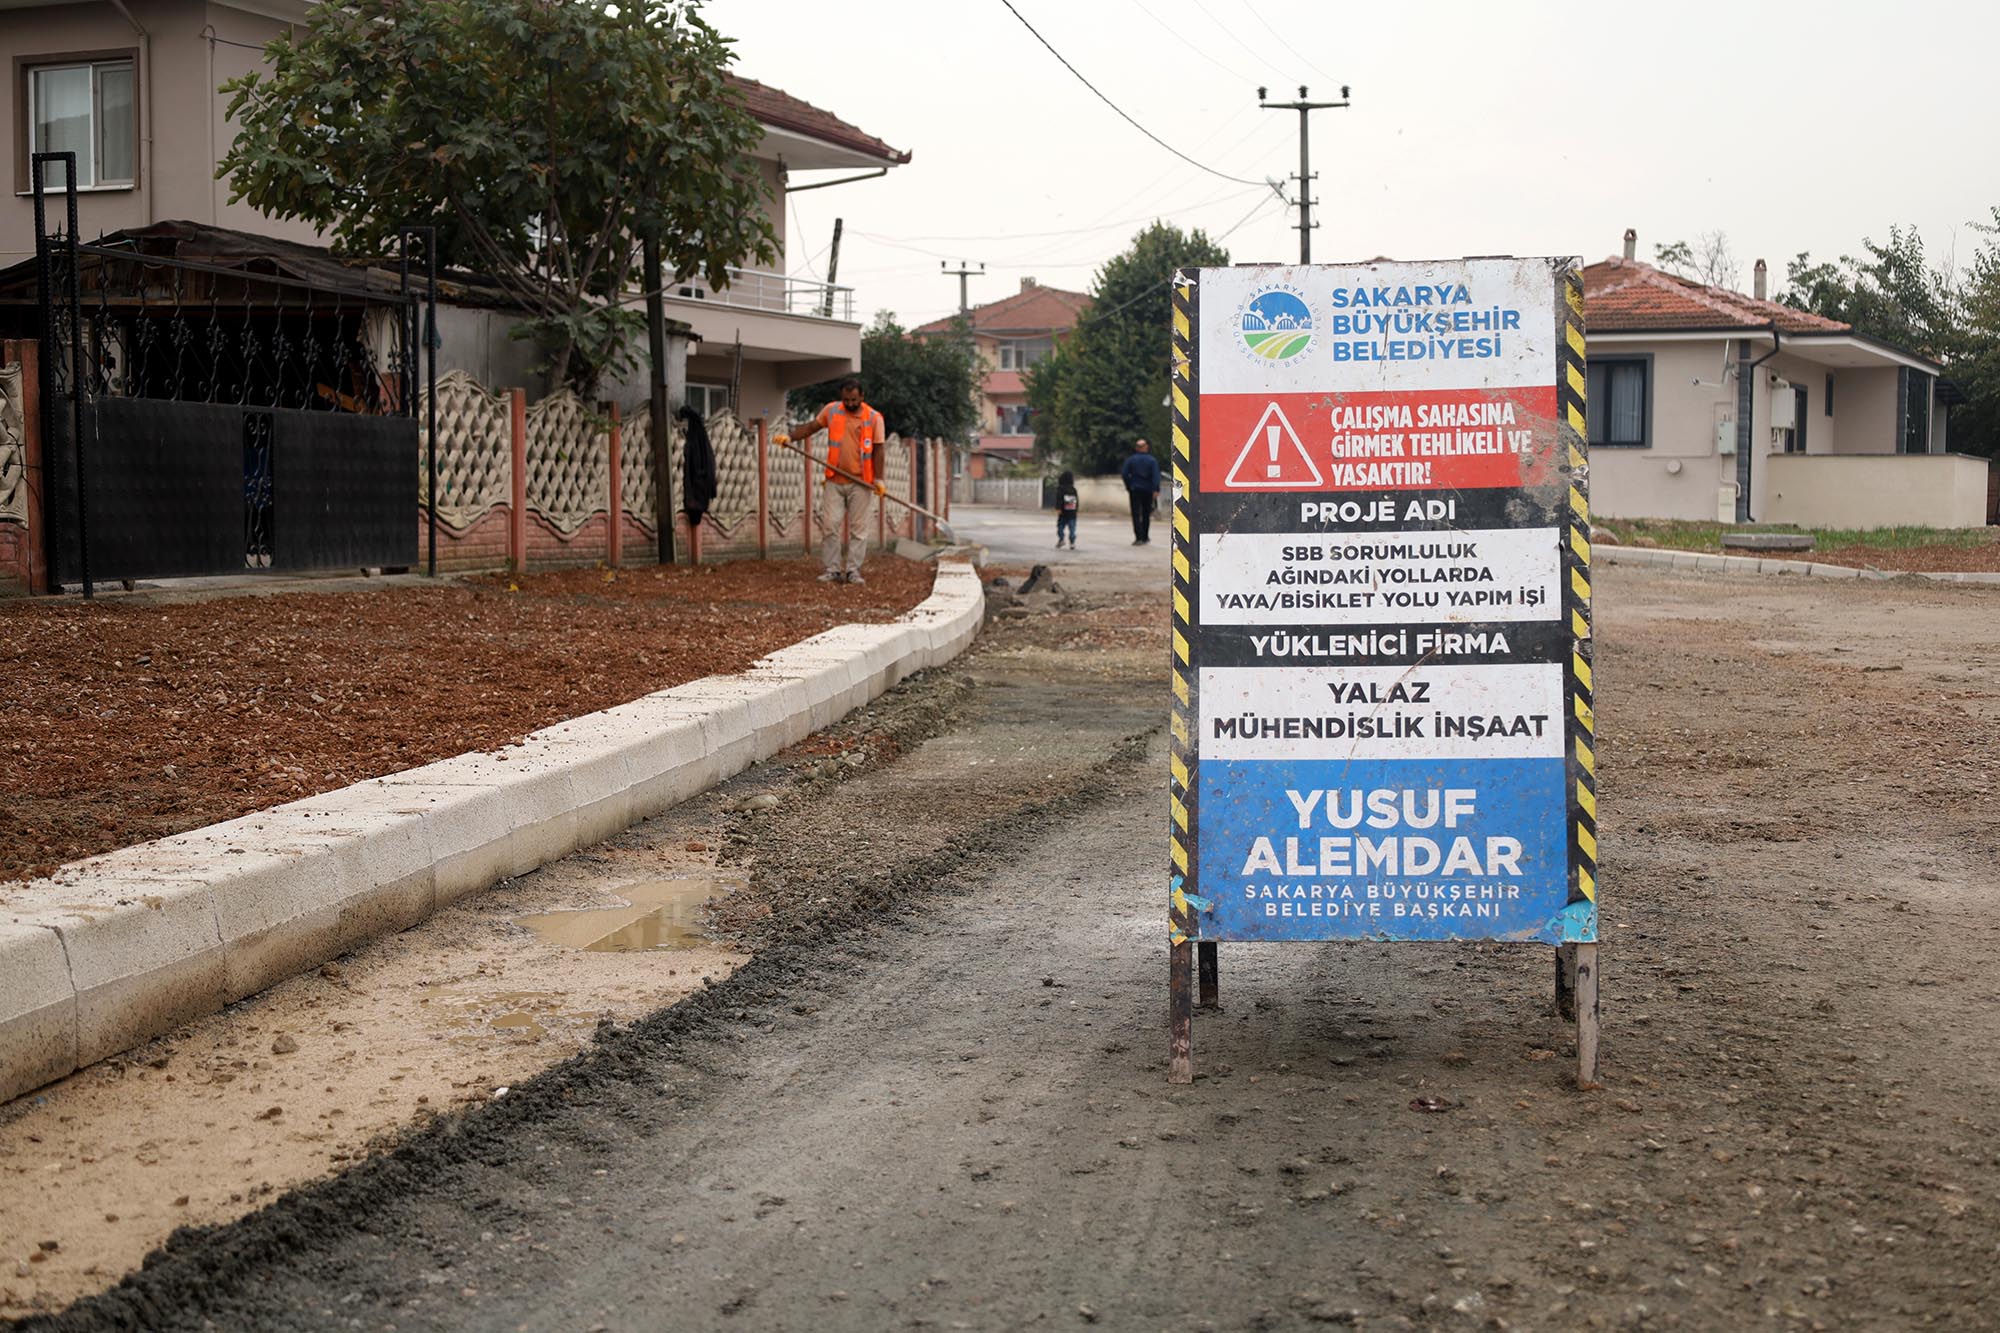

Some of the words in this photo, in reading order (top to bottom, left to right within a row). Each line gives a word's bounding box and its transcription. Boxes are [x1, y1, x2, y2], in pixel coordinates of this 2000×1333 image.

[1332, 285, 1472, 308] SAKARYA
[1332, 306, 1521, 335] BÜYÜKŞEHİR
[1333, 333, 1502, 362] BELEDİYESİ
[1331, 405, 1413, 433] ÇALIŞMA
[1417, 402, 1516, 428] SAHASINA
[1331, 430, 1406, 458] GİRMEK
[1409, 427, 1503, 457] TEHLİKELİ
[1507, 430, 1532, 453] VE
[1331, 462, 1432, 487] YASAKTIR!
[1301, 501, 1396, 523] PROJE
[1404, 500, 1456, 521] ADI
[1282, 545, 1323, 562] SBB
[1330, 542, 1477, 561] SORUMLULUK
[1266, 565, 1370, 585] AĞINDAKİ
[1377, 567, 1494, 584] YOLLARDA
[1216, 590, 1376, 612] YAYA/BİSİKLET
[1382, 592, 1439, 608] YOLU
[1446, 590, 1512, 607] YAPIM
[1520, 585, 1546, 607] İŞİ
[1250, 629, 1407, 656] YÜKLENİCİ
[1416, 629, 1511, 655] FİRMA
[1328, 682, 1430, 704] YALAZ
[1214, 712, 1425, 740] MÜHENDİSLİK
[1434, 711, 1549, 742] İNŞAAT
[1285, 789, 1477, 829] YUSUF
[1241, 836, 1523, 876] ALEMDAR
[1245, 885, 1355, 899] SAKARYA
[1367, 881, 1520, 901] BÜYÜKŞEHİR
[1265, 900, 1381, 917] BELEDİYE
[1394, 903, 1500, 919] BAŞKANI
